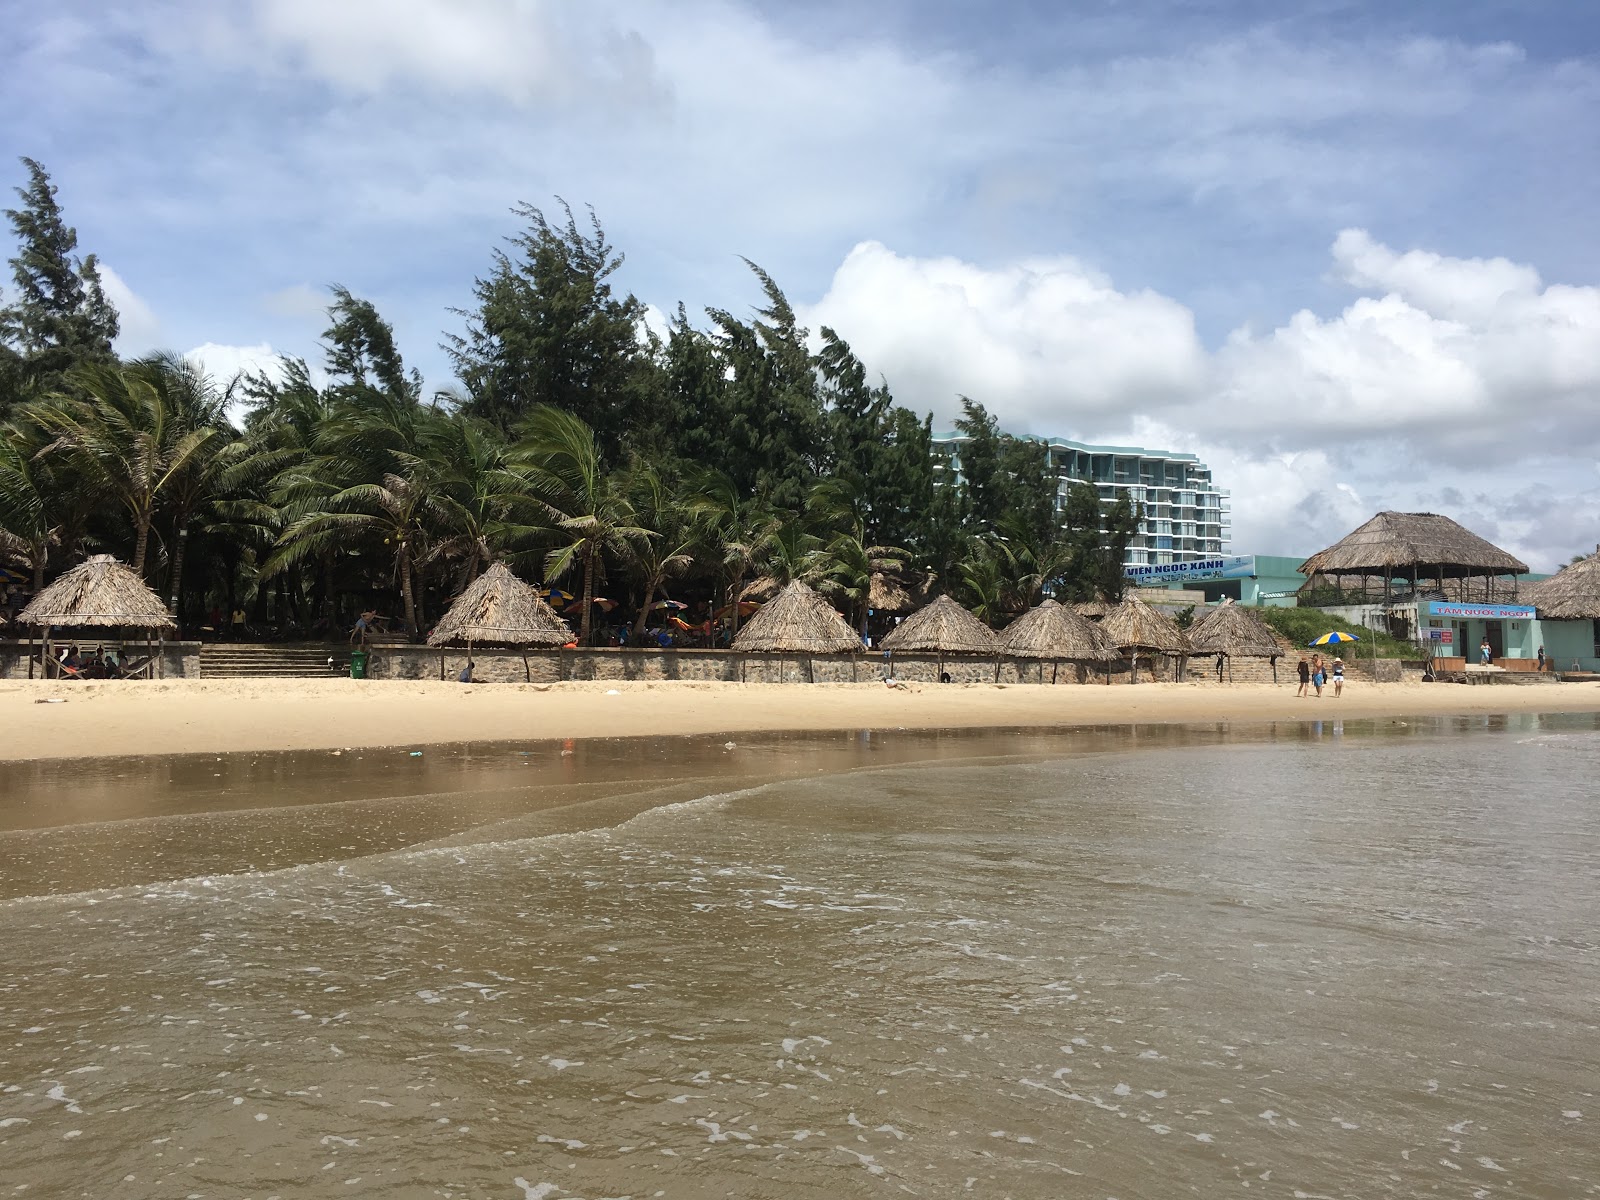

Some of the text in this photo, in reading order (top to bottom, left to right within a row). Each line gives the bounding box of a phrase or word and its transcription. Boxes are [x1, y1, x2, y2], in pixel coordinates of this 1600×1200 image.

[1127, 566, 1152, 576] VIÊN
[1155, 564, 1187, 573] NGỌC
[1190, 560, 1224, 570] XANH
[1499, 610, 1529, 618] NGỌT
